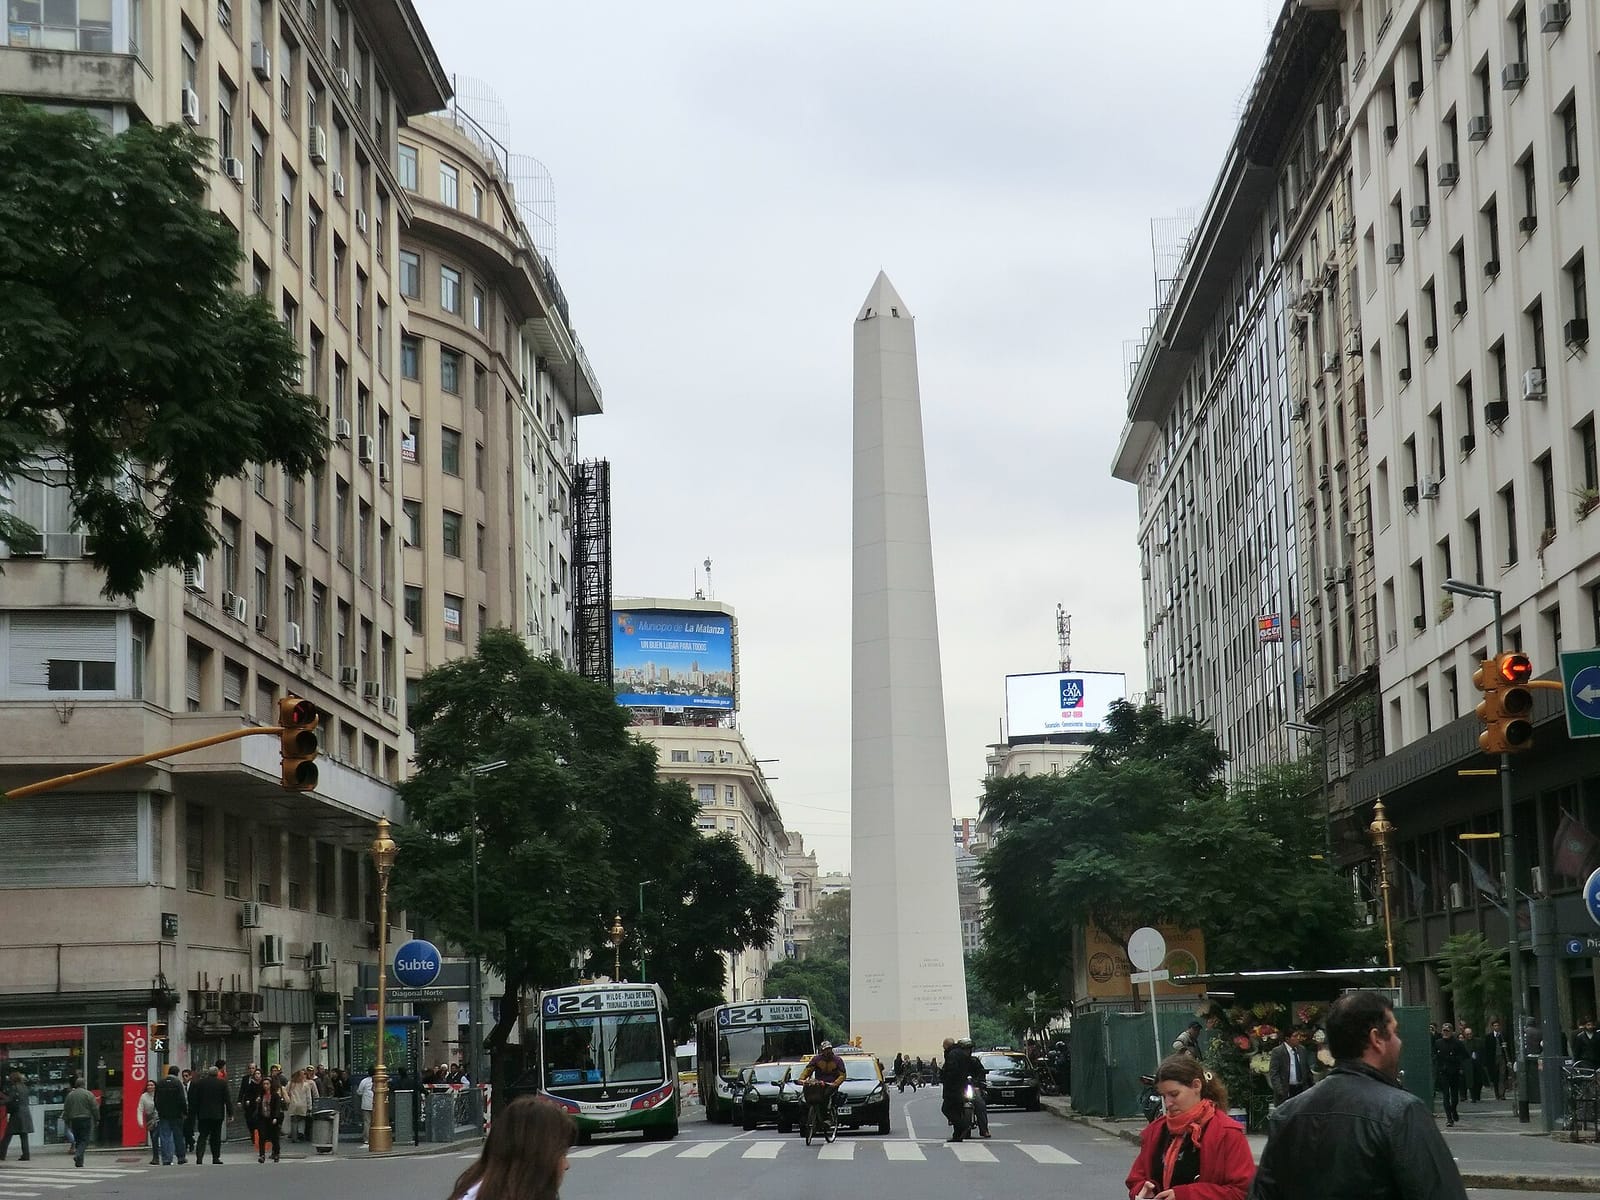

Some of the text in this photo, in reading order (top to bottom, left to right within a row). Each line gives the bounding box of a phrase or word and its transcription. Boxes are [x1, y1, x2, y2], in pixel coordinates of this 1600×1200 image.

[638, 621, 725, 635] Municipio de La Matanza
[641, 640, 707, 651] UN BUEN LUGAR PARA TODOS
[397, 958, 435, 971] Subte
[391, 989, 423, 998] Diagonal
[559, 995, 604, 1013] 24
[731, 1008, 763, 1023] 24
[132, 1037, 146, 1081] Claro
